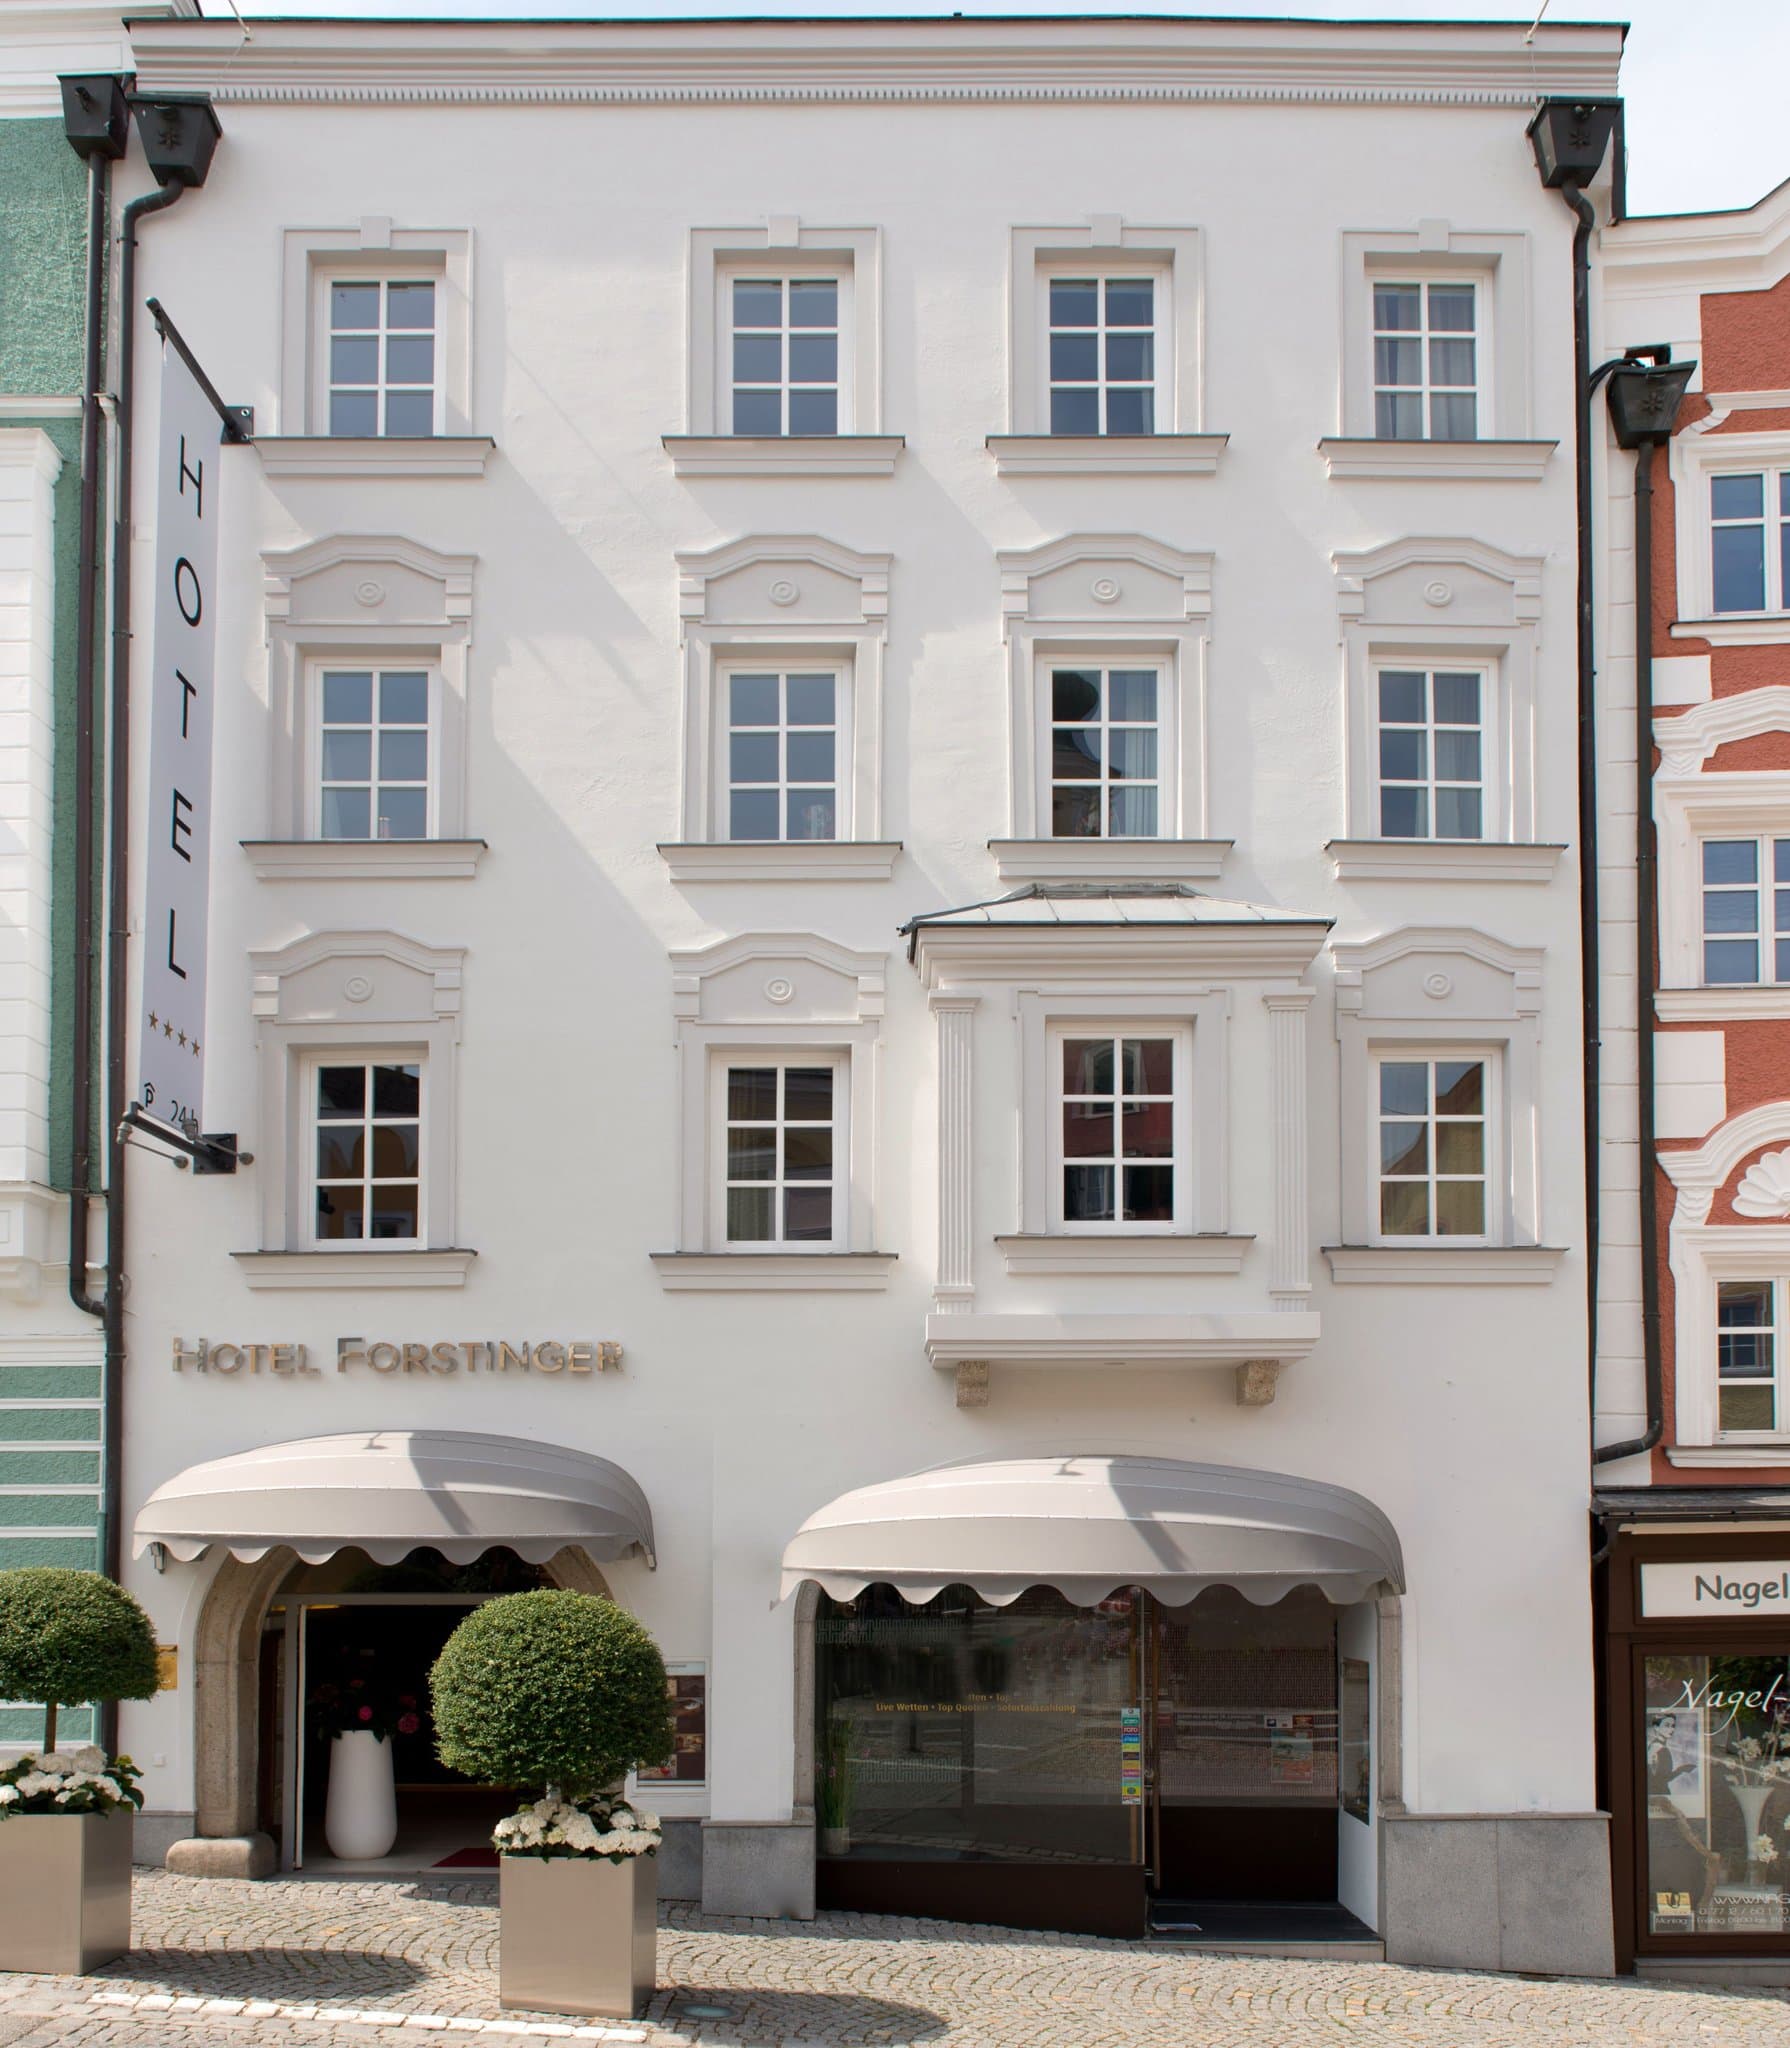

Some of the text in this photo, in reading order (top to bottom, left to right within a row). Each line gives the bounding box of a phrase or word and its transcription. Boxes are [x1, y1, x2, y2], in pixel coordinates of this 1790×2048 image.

[169, 434, 203, 980] HOTEL
[1695, 1572, 1789, 1608] Nagel
[876, 1703, 894, 1712] Live
[897, 1703, 929, 1712] Wetten
[937, 1703, 953, 1714] Top
